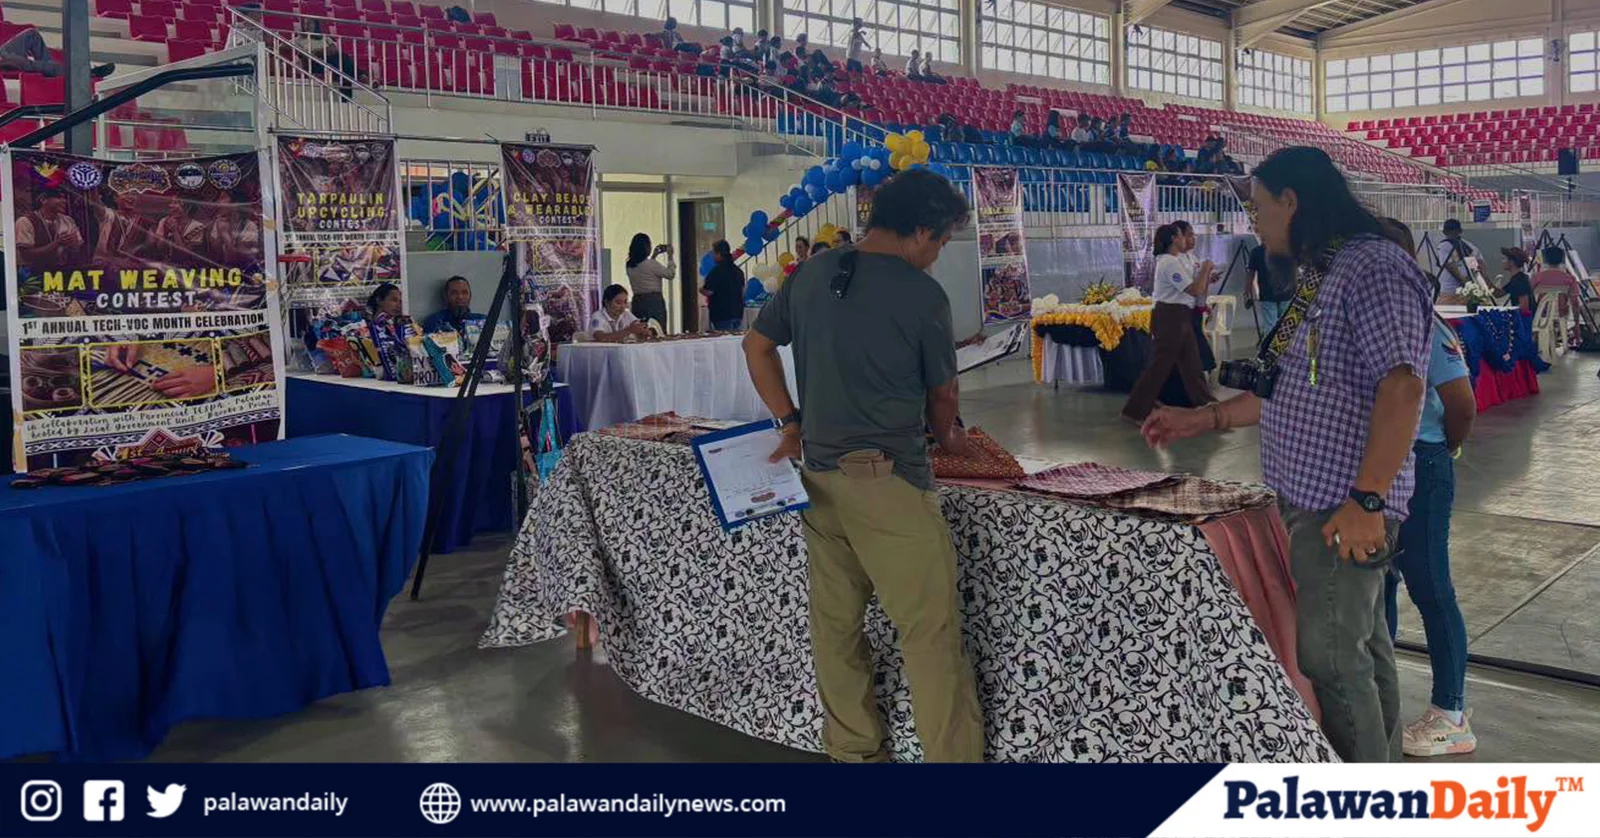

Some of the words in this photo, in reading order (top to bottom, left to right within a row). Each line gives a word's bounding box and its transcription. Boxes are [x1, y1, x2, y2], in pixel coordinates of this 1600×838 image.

[297, 192, 384, 205] TARPAULIN
[513, 193, 548, 204] CLAY
[297, 206, 385, 218] UPCYCLING
[507, 205, 516, 215] &
[319, 219, 367, 229] CONTEST
[540, 216, 577, 224] CONTEST
[42, 269, 105, 293] MAT
[119, 267, 244, 290] WEAVING
[96, 291, 197, 309] CONTEST
[42, 320, 89, 335] ANNUAL
[93, 318, 149, 332] TECH-VOC
[153, 316, 192, 330] MONTH
[195, 313, 265, 328] CELEBRATION
[113, 413, 135, 423] with
[67, 426, 79, 436] by
